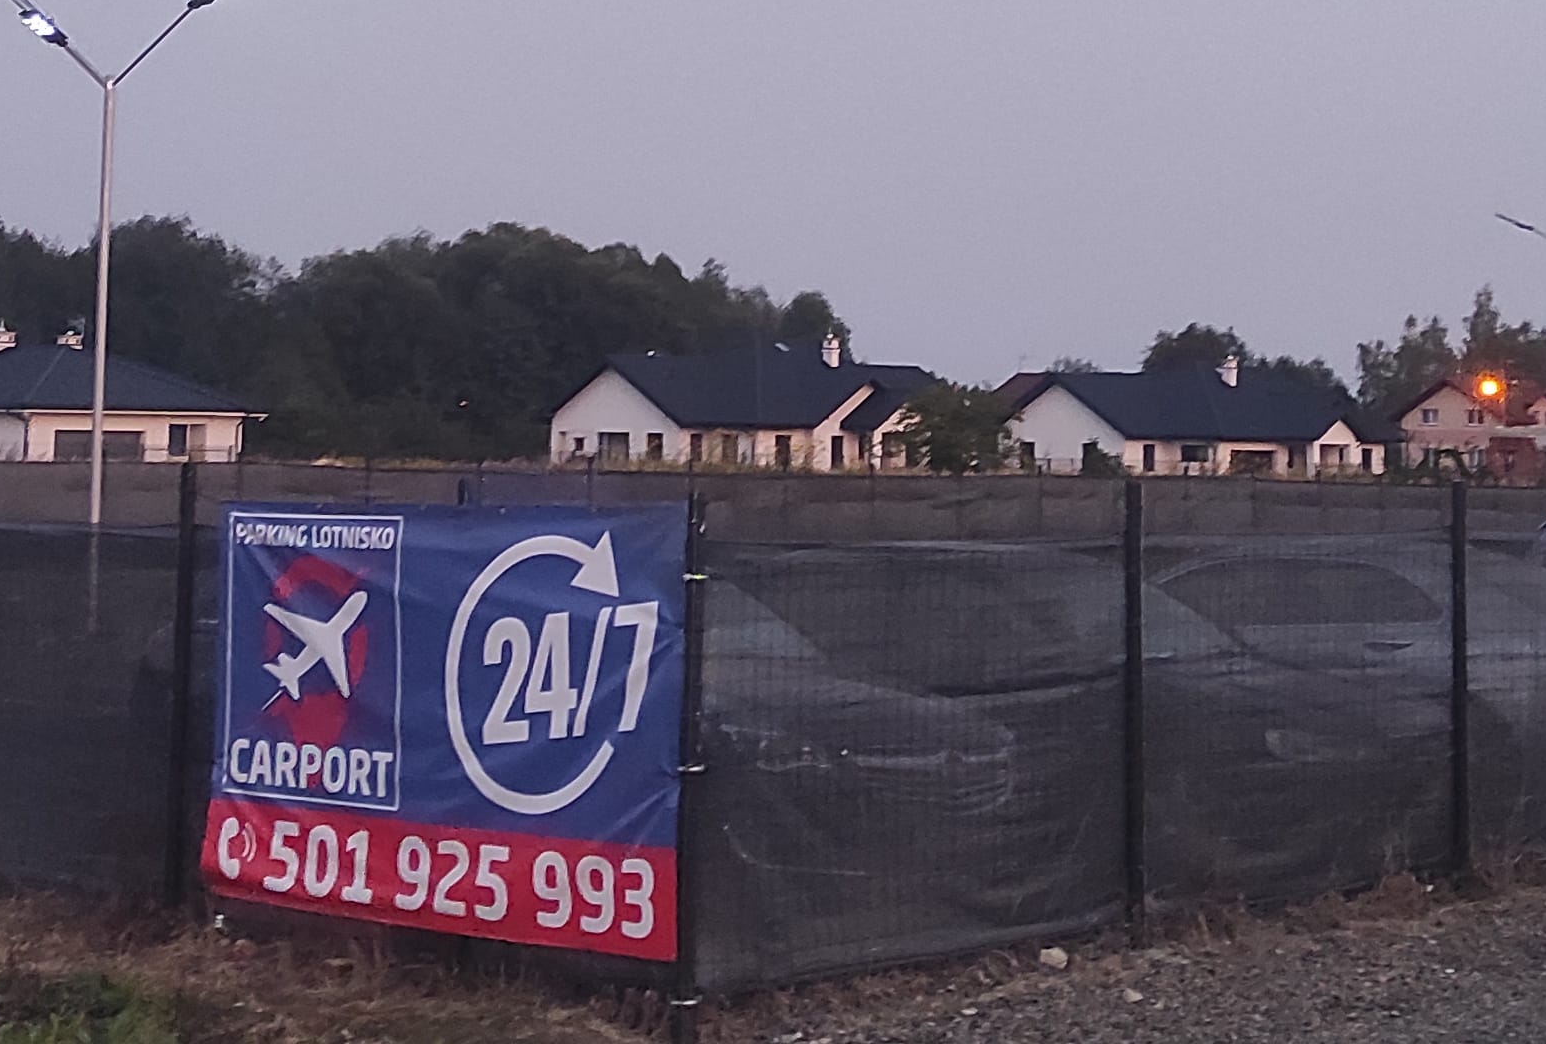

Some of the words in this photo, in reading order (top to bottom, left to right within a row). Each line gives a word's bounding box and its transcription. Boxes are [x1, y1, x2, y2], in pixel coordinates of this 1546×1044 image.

[235, 522, 308, 547] PARKING
[311, 525, 396, 549] LOTNISKO
[482, 601, 659, 745] 24/7
[229, 738, 393, 798] CARPORT
[263, 819, 372, 905] 501
[394, 836, 510, 922] 925
[532, 851, 655, 939] 993
